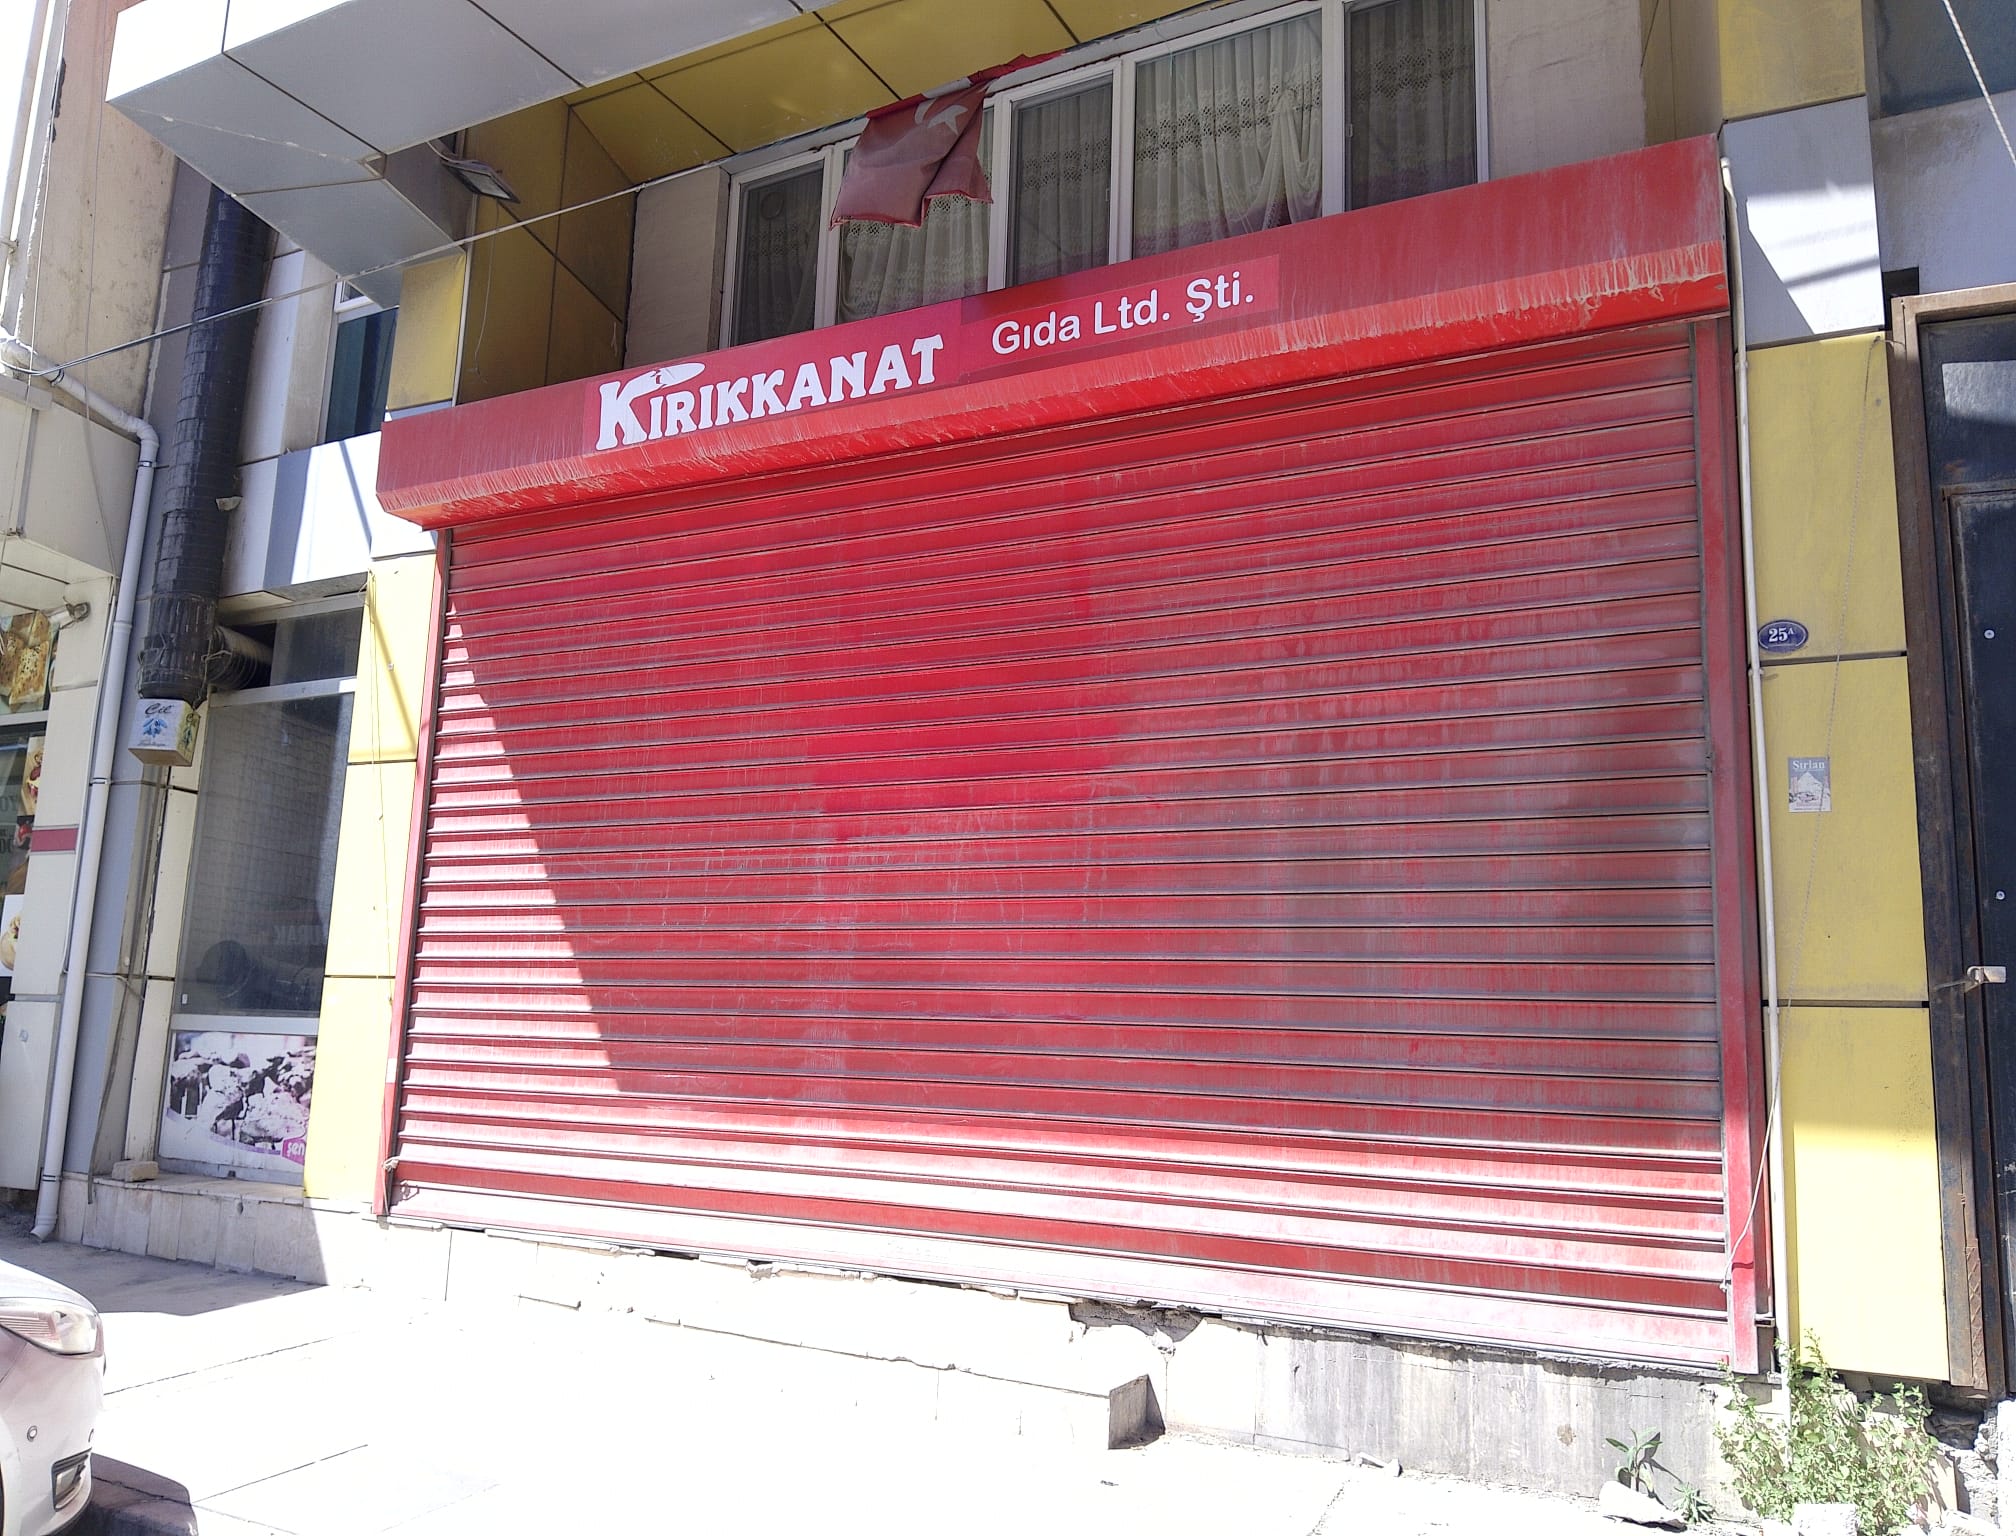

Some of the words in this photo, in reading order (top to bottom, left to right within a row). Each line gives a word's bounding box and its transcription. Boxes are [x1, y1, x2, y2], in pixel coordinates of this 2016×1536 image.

[596, 334, 943, 450] KIRIKKANAT
[992, 311, 1080, 354] Gıda
[1094, 289, 1170, 334] Ltd.
[1186, 271, 1253, 322] Şti.
